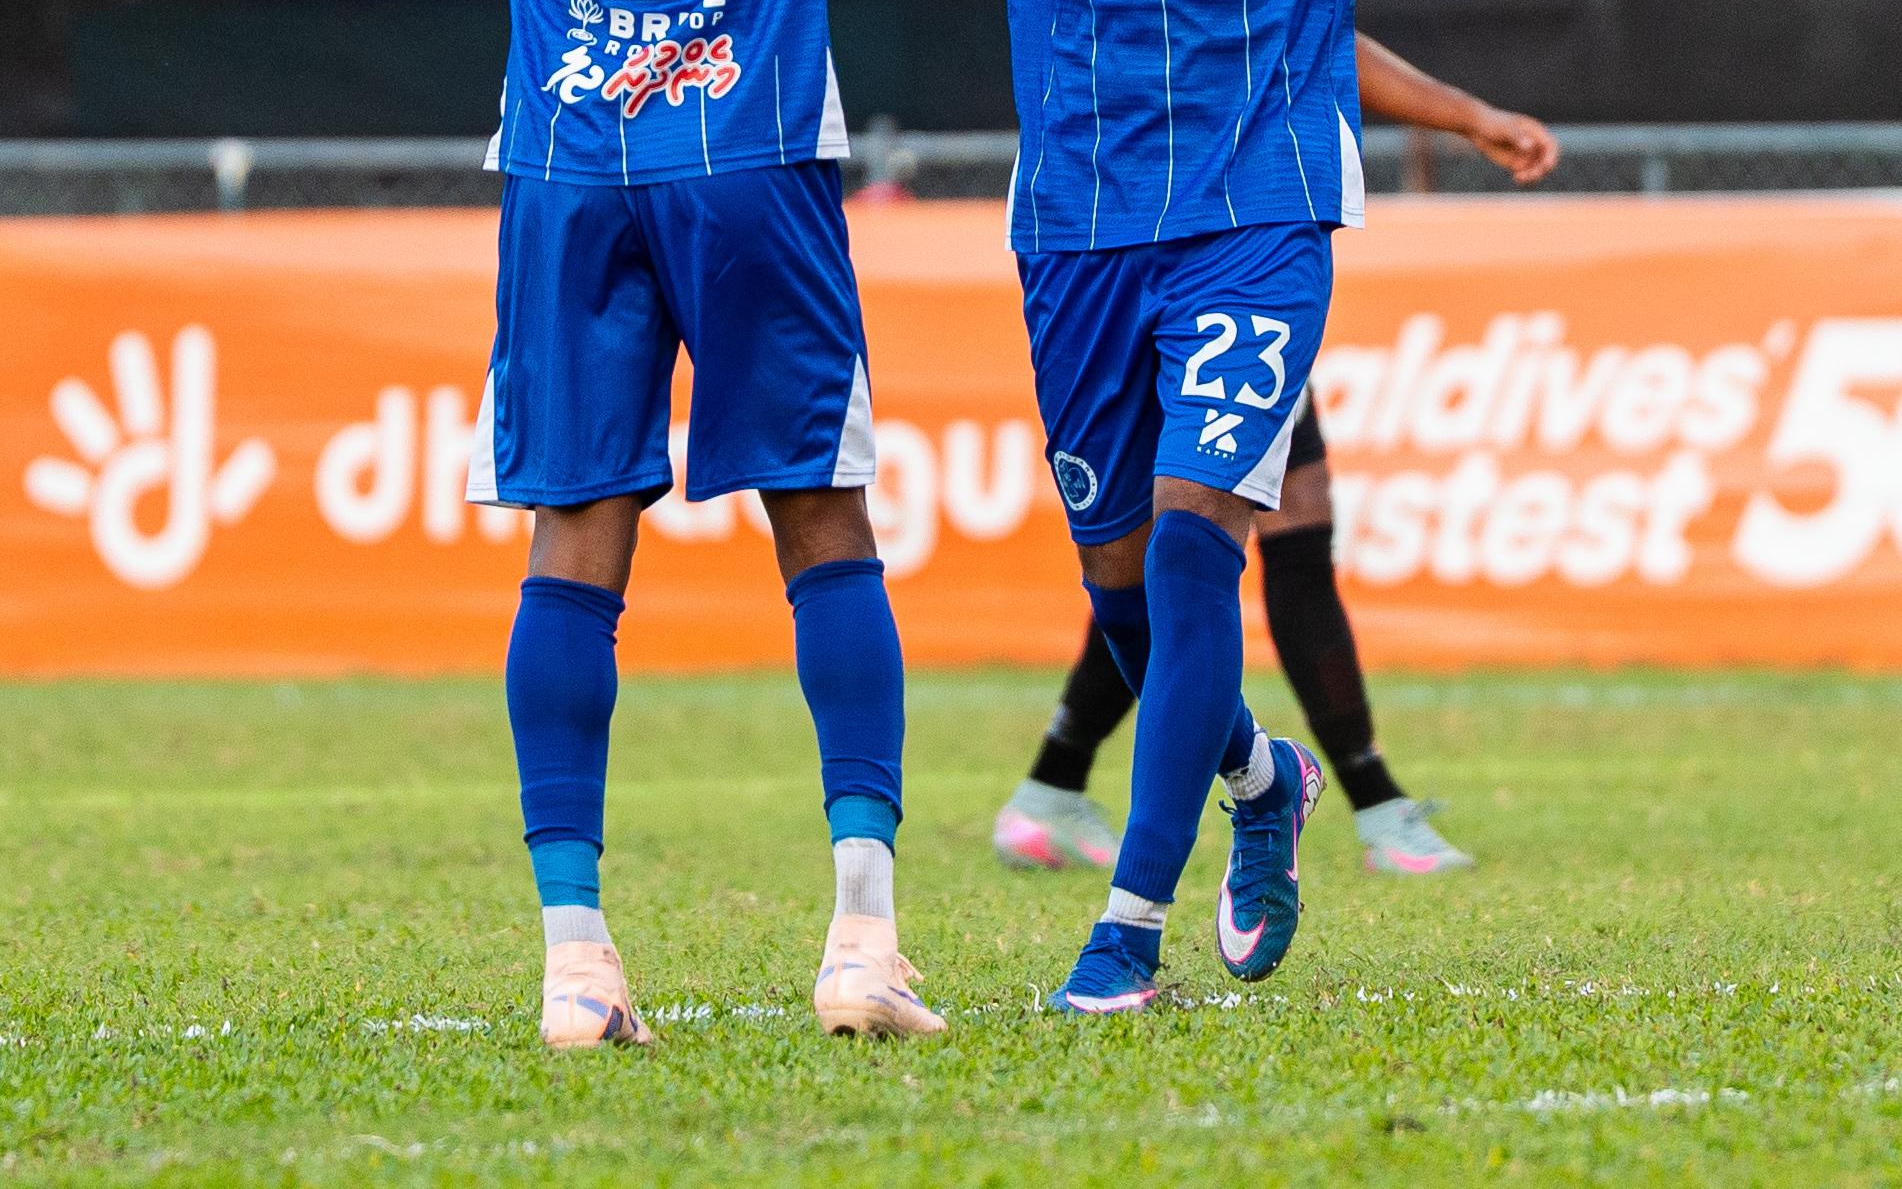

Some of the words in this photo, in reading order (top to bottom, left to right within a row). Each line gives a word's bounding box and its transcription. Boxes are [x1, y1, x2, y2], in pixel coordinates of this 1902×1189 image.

[1180, 312, 1291, 410] 23
[1308, 310, 1797, 453] aldives'
[1329, 449, 1710, 586] stest
